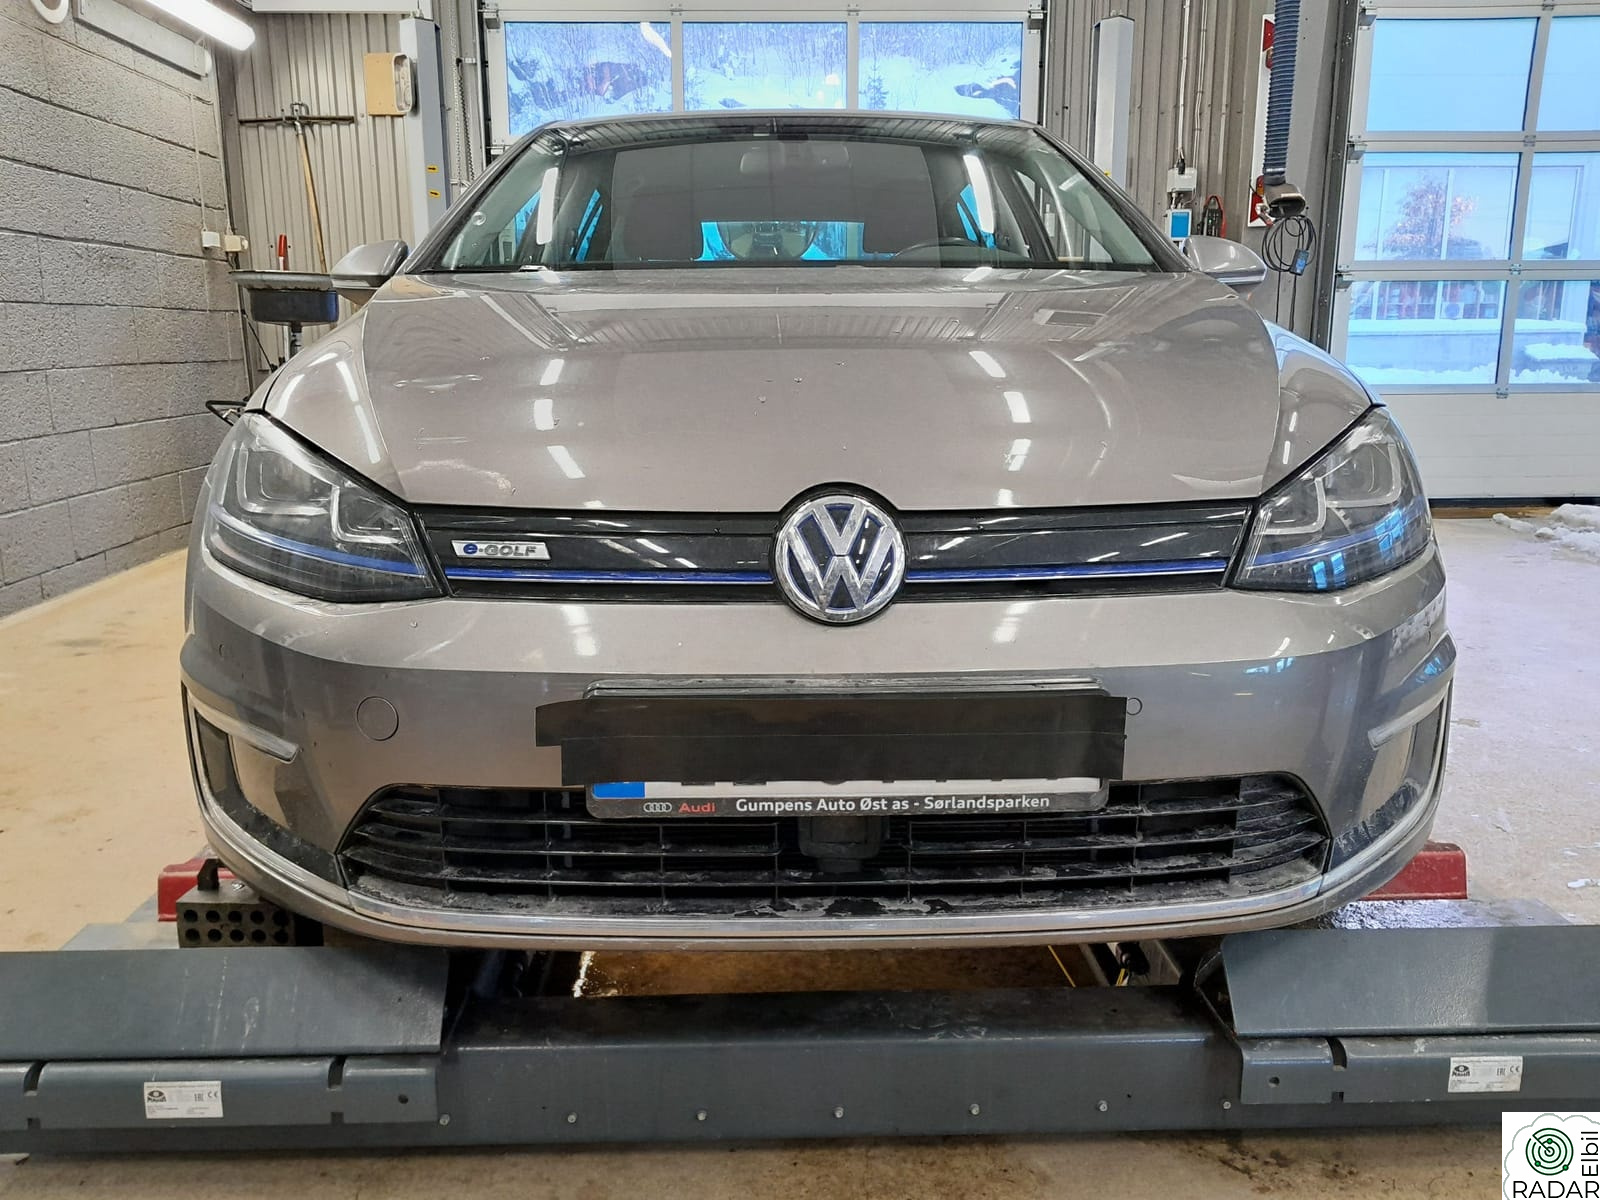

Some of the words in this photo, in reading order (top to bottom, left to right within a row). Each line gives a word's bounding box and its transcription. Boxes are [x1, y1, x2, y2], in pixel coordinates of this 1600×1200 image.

[679, 802, 716, 813] Audi
[736, 798, 812, 814] Gumpens
[816, 798, 856, 811] Auto
[860, 797, 888, 811] Øst
[892, 800, 909, 810] as
[924, 795, 1050, 811] Sørlandsparken
